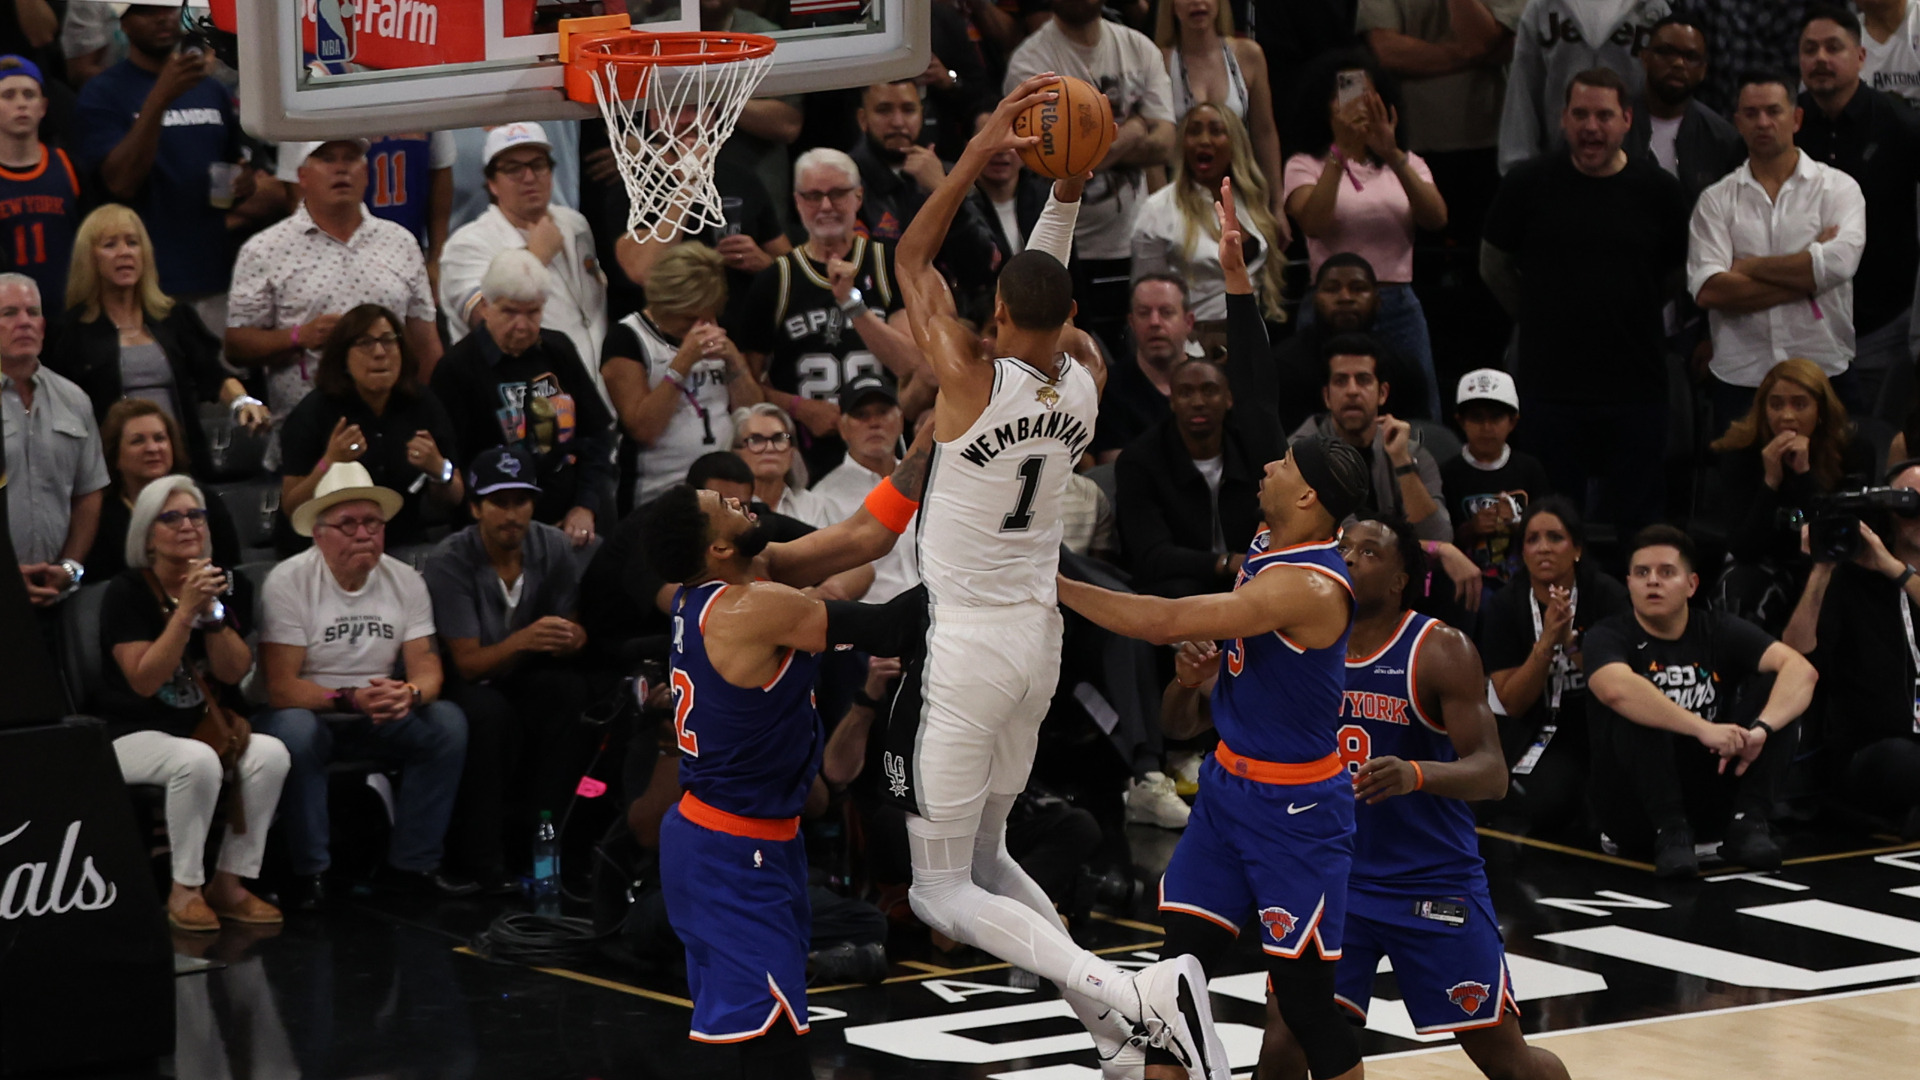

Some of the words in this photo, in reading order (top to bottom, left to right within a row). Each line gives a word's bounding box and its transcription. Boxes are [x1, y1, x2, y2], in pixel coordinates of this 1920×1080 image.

[321, 39, 341, 56] NBA
[373, 150, 408, 208] 11
[14, 222, 47, 267] 11
[999, 454, 1048, 533] 1
[324, 621, 395, 645] SPURS
[669, 666, 699, 758] 2
[1349, 692, 1411, 726] YORK
[1336, 724, 1372, 790] 8
[0, 820, 118, 920] als
